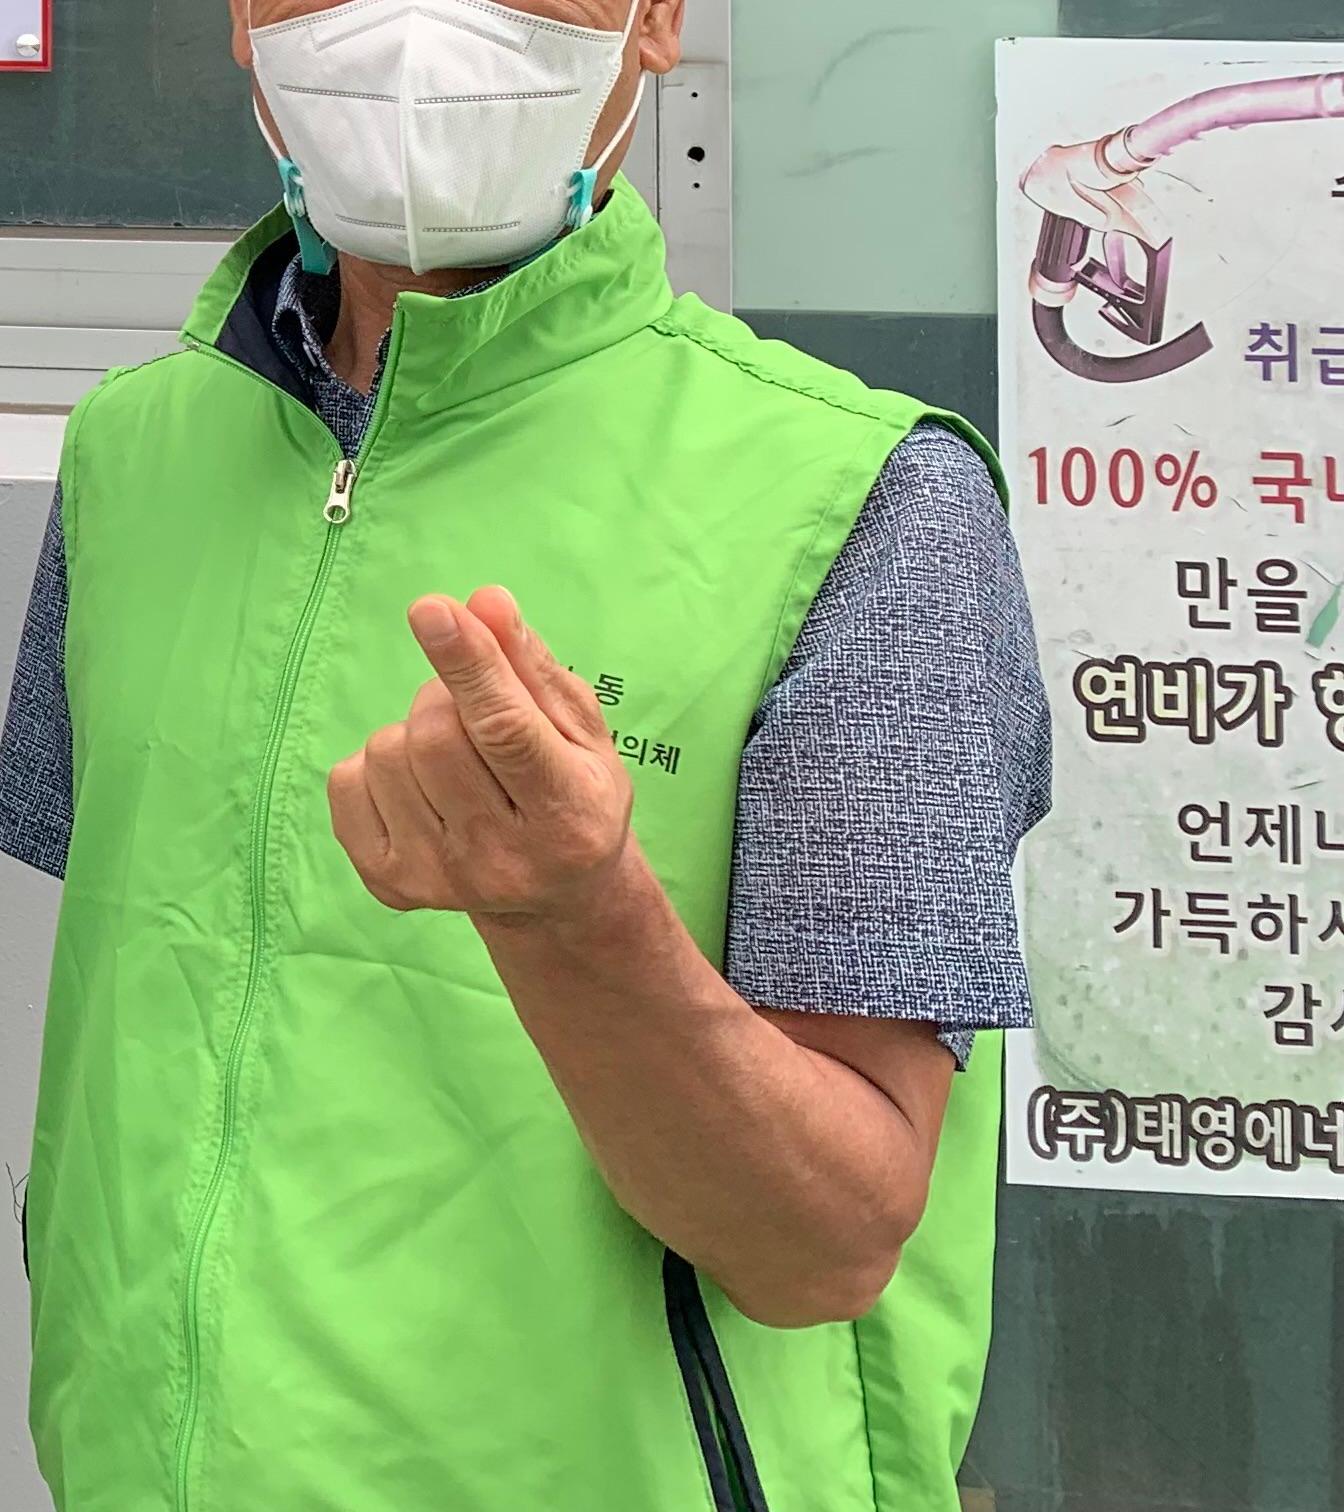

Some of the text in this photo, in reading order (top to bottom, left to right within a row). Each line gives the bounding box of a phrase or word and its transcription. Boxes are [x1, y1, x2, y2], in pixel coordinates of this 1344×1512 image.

[1027, 446, 1218, 512] 100%
[1175, 556, 1308, 634] 만을
[593, 673, 625, 706] 동
[1073, 654, 1293, 748] 연비가
[1263, 982, 1344, 1047] 감
